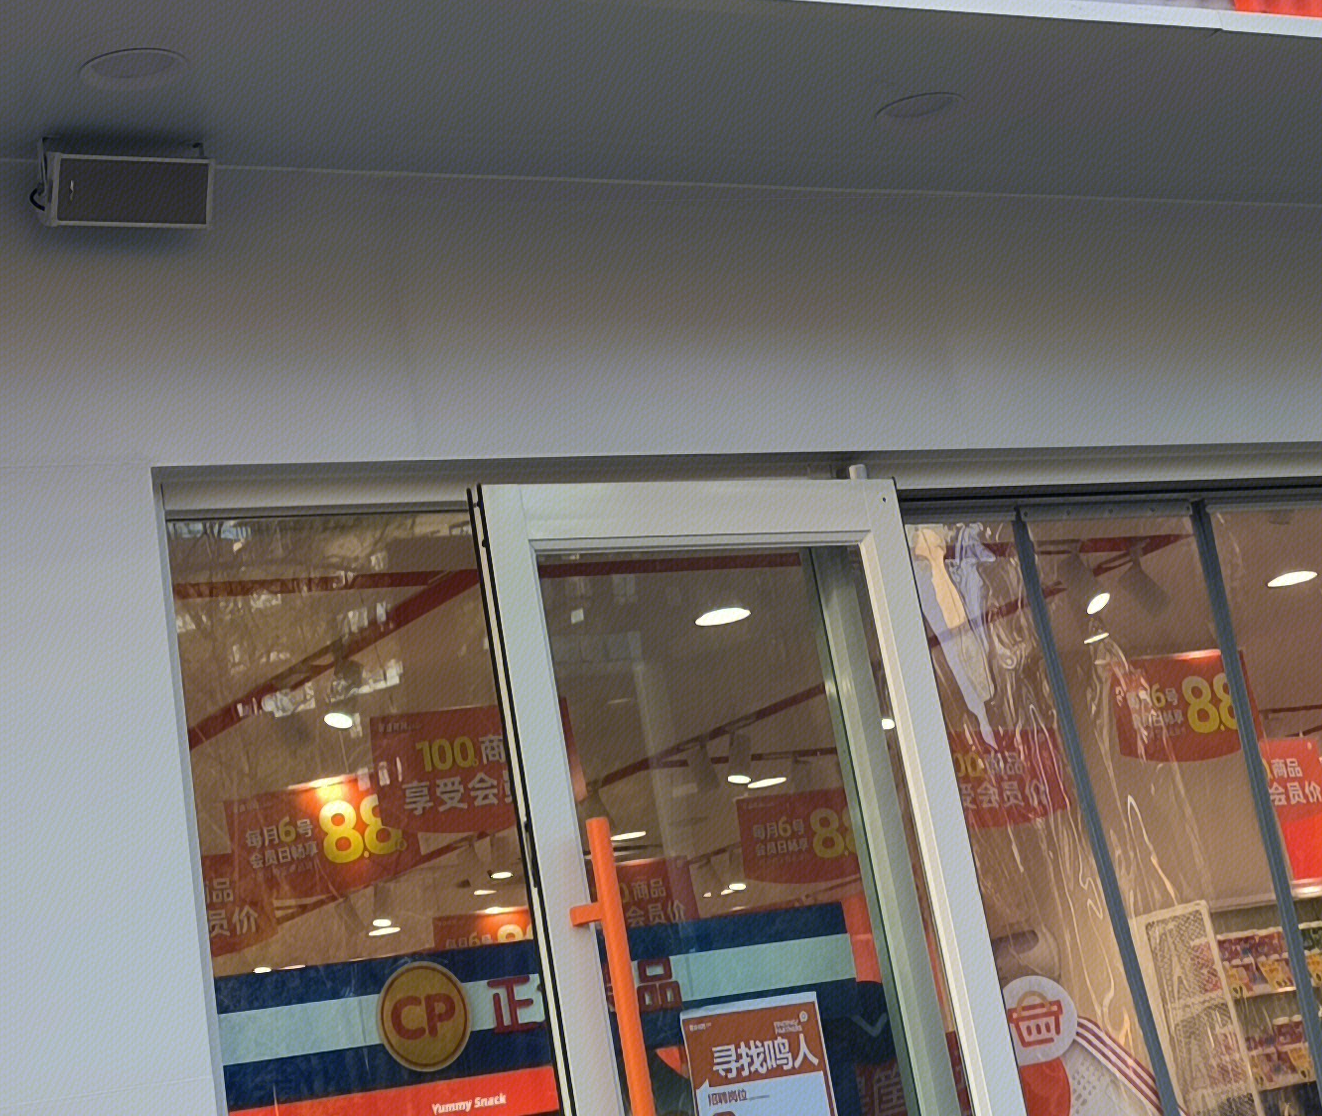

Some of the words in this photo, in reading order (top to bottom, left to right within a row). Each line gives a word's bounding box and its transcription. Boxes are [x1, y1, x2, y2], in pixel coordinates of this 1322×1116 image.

[1271, 758, 1304, 779] 商品
[1269, 779, 1322, 806] 会员价
[245, 816, 314, 849] 每月6号
[752, 816, 805, 840] 每月6号
[249, 841, 318, 870] 会员日畅享
[390, 993, 457, 1041] CP
[710, 1033, 820, 1079] 寻找鸣人
[431, 1099, 473, 1116] Yummy
[473, 1092, 507, 1110] Snack
[708, 1088, 749, 1107] 招聘岗位
